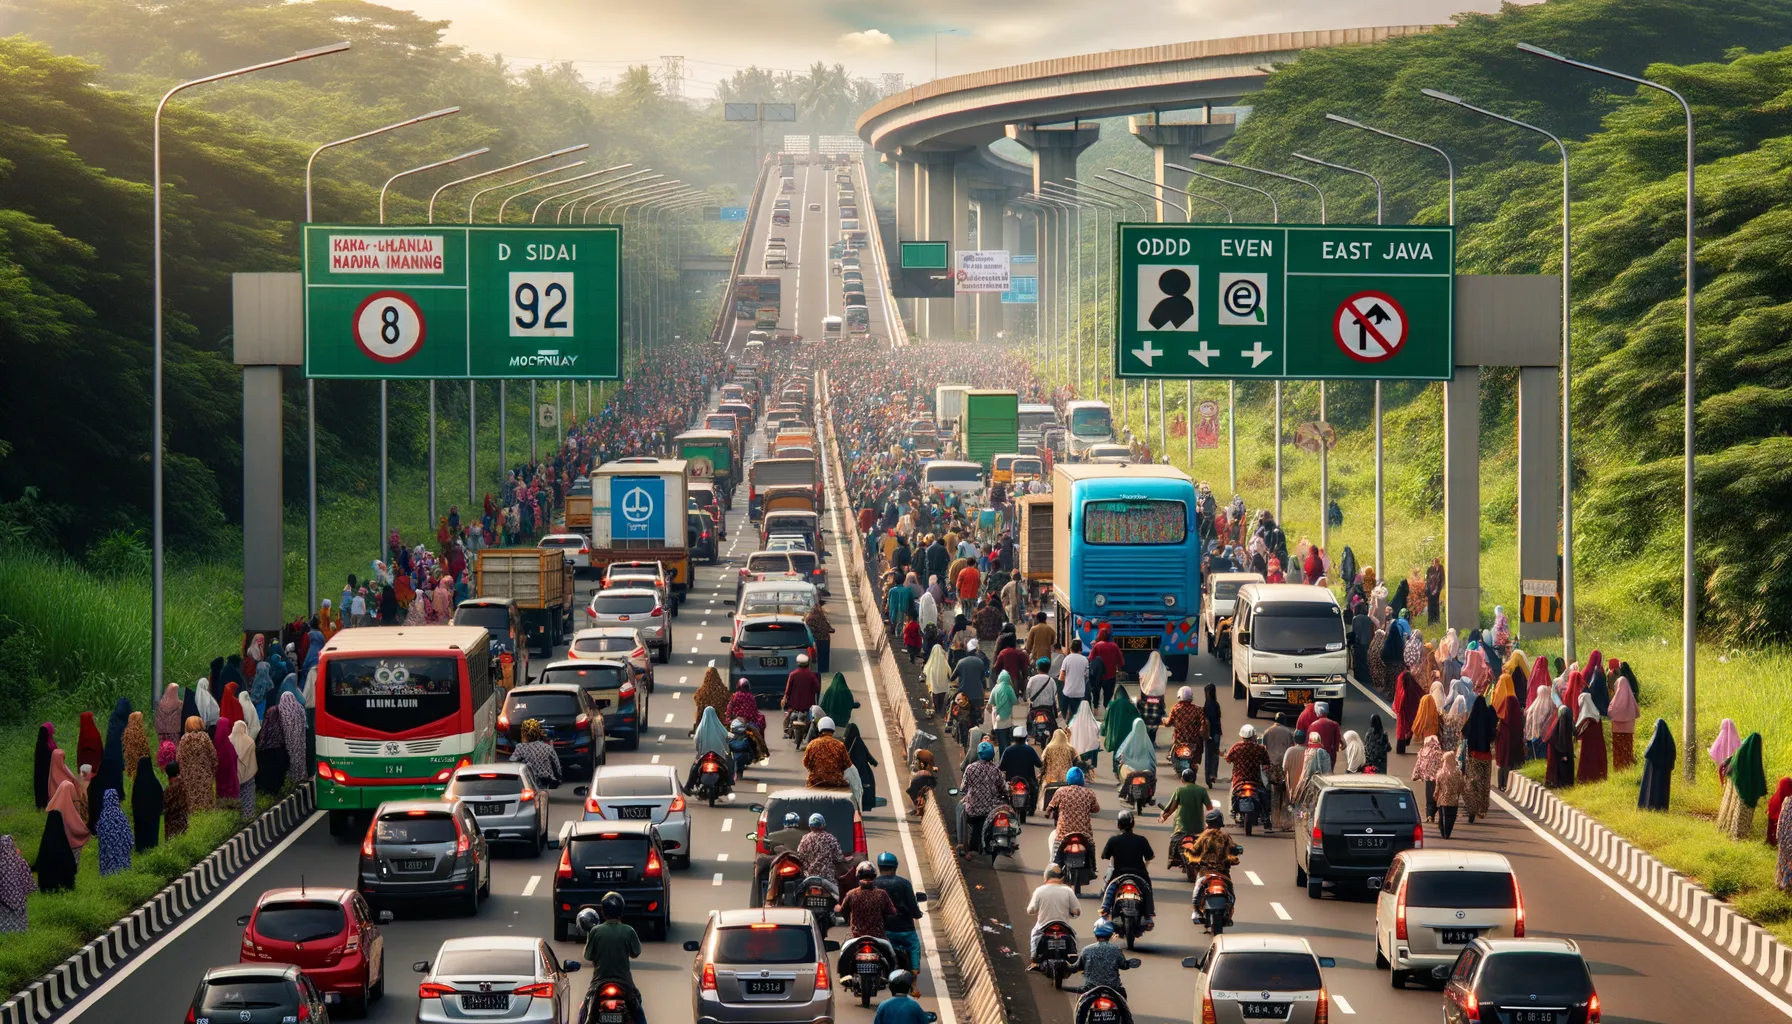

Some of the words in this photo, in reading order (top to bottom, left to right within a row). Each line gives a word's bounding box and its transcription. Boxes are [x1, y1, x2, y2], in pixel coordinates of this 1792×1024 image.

[498, 243, 511, 261] D
[526, 243, 576, 261] SIDAI
[1137, 238, 1191, 256] ODDD
[1221, 239, 1273, 257] EVEN
[1322, 241, 1373, 260] EAST
[1382, 242, 1433, 260] JAVA
[515, 282, 568, 329] 92
[381, 306, 400, 344] 8
